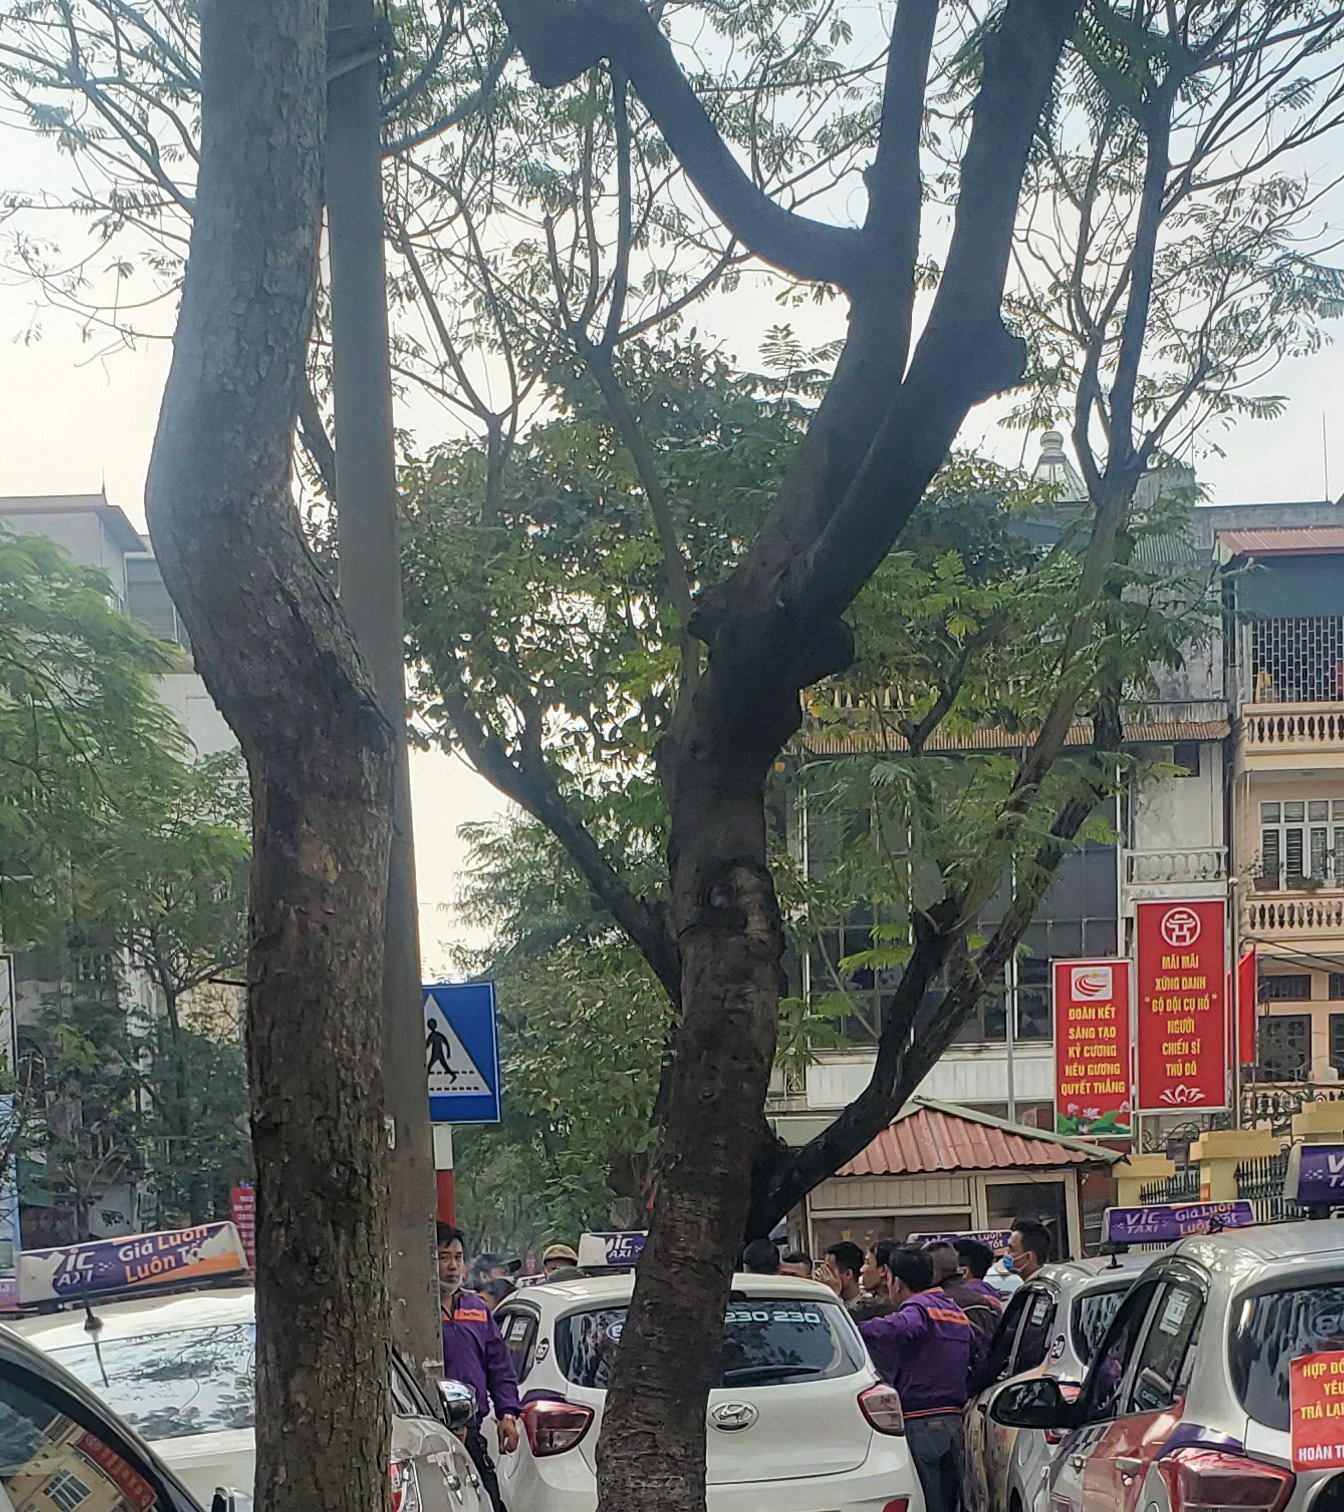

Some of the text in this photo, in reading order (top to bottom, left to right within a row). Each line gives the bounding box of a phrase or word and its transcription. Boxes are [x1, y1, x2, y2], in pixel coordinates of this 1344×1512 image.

[1181, 976, 1206, 990] DANH
[1097, 1003, 1116, 1019] KẾT
[1097, 1026, 1116, 1041] TẠO
[118, 1238, 153, 1262] Giá
[125, 1258, 176, 1283] Luôn
[724, 1311, 821, 1323] 230 230
[1303, 1363, 1327, 1377] HỢP
[1300, 1401, 1323, 1420] TRẢ
[1326, 1402, 1344, 1418] LẠI
[1298, 1444, 1333, 1461] HOÀN
